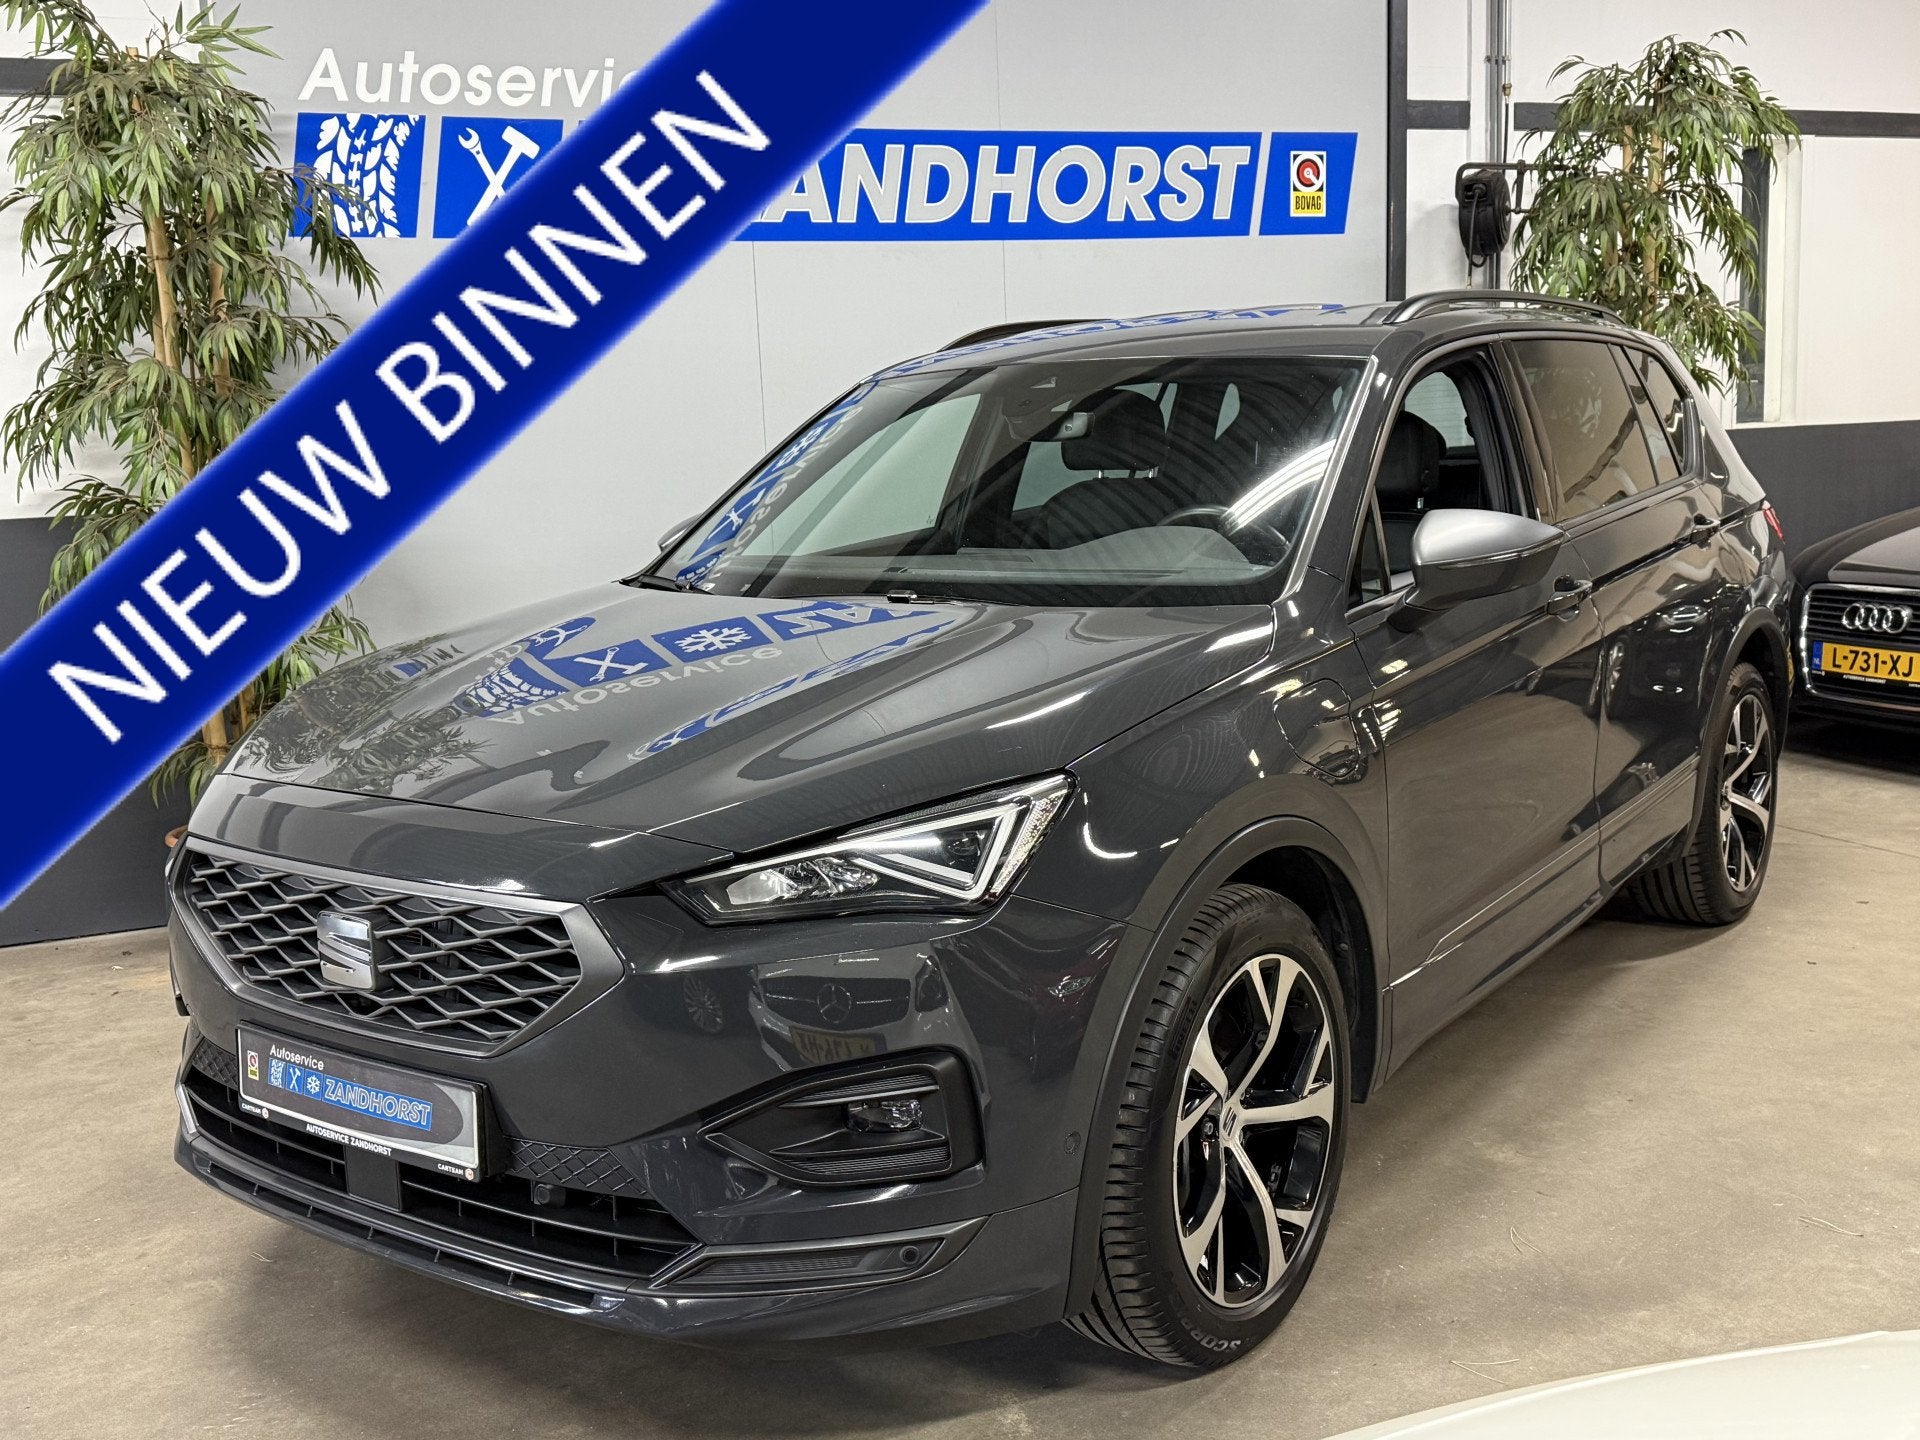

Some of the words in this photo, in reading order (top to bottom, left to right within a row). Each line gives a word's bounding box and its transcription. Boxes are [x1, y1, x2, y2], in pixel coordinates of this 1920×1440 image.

[298, 47, 641, 110] Autoservi
[752, 143, 1252, 223] ANDHORST
[1295, 195, 1322, 211] BOVAG
[1832, 647, 1914, 678] L-731-XJ
[269, 1044, 325, 1071] Autoservice
[325, 1079, 431, 1125] ZANDHORST
[306, 1123, 350, 1144] AUTOSERVICE
[350, 1136, 392, 1156] ZANDHORST
[437, 1163, 464, 1176] CARTEAM
